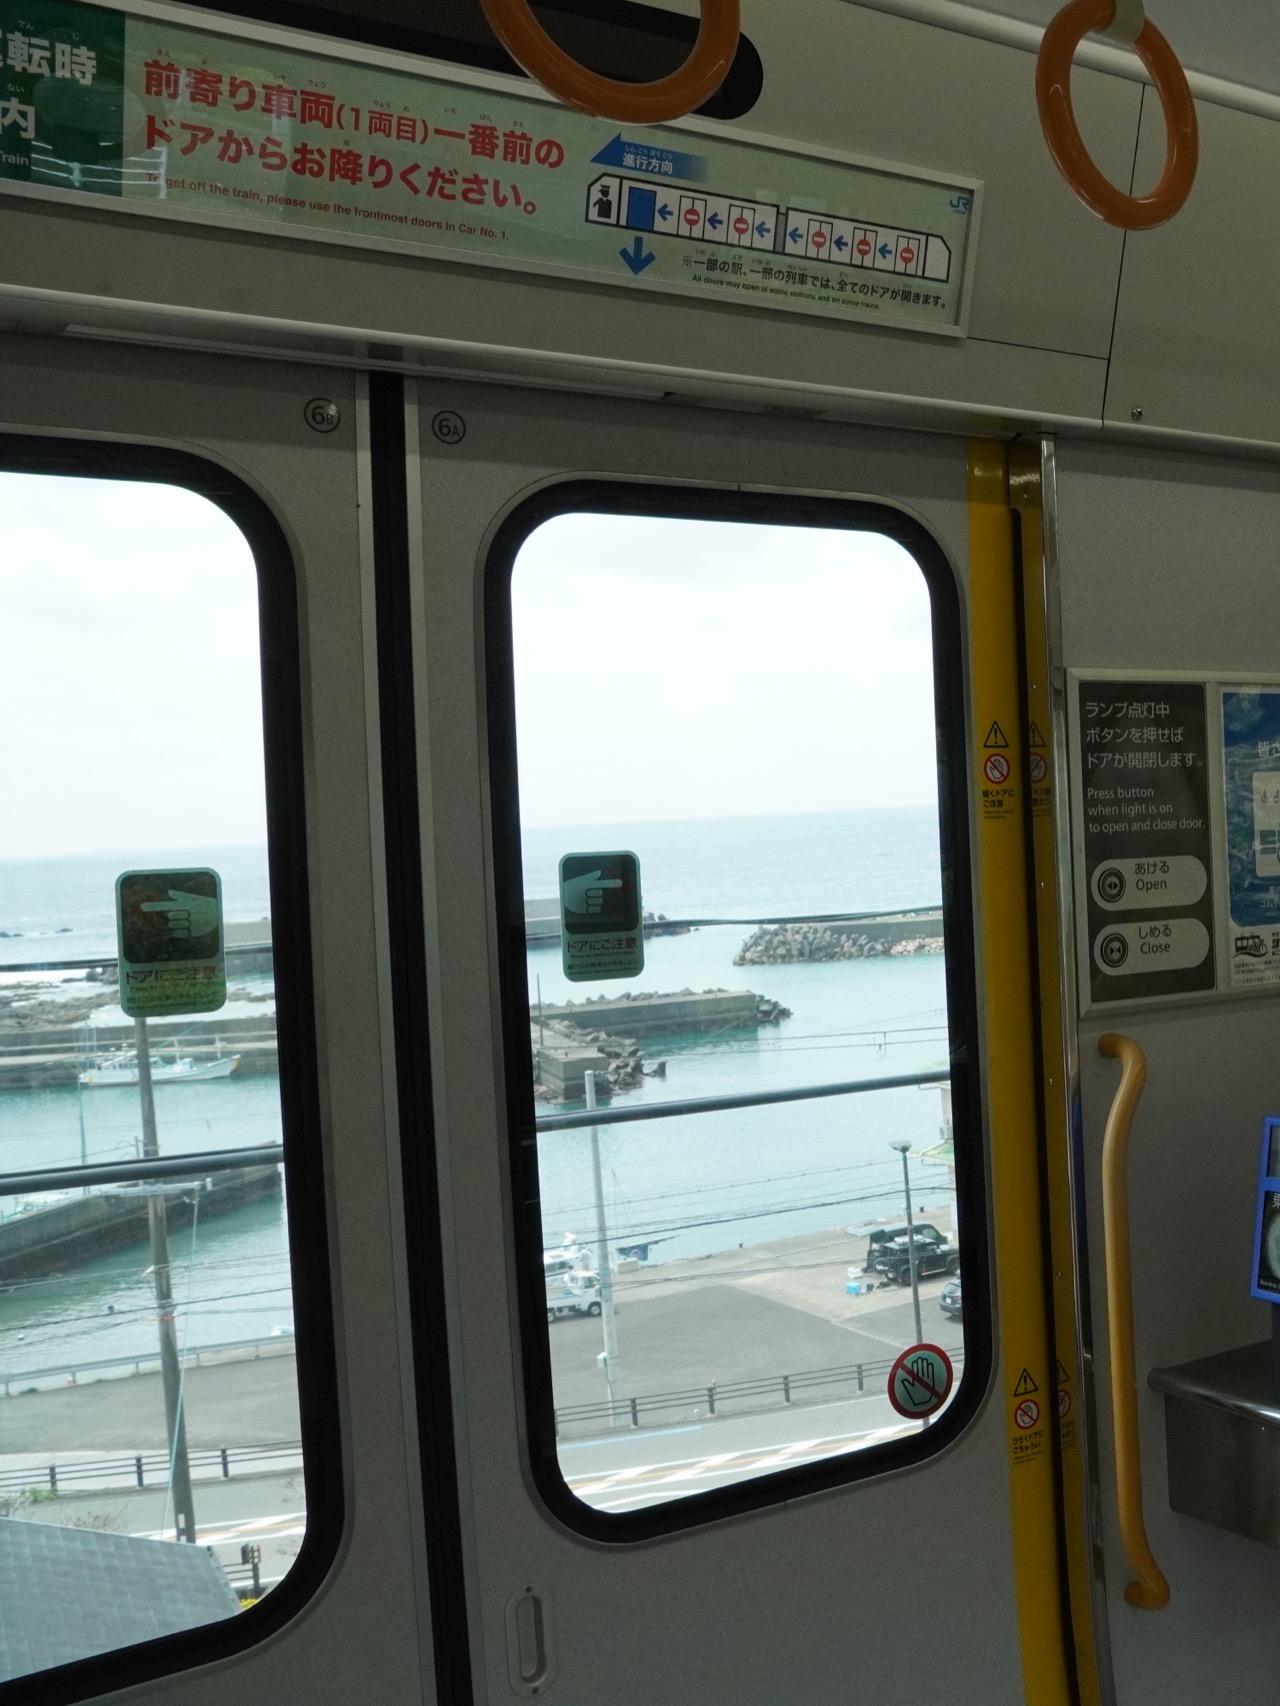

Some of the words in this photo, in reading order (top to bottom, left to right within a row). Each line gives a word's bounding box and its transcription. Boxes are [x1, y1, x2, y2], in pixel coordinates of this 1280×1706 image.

[0, 28, 97, 85] 転時
[143, 60, 565, 168] 前寄り車両(1両目)一番前の
[147, 115, 536, 214] ドアからお降りください。
[622, 152, 674, 174] 進行方向
[165, 177, 185, 190] get
[189, 180, 207, 191] off
[209, 183, 229, 196] the
[232, 187, 264, 203] train,
[266, 193, 306, 208] please
[309, 201, 330, 211] use
[333, 203, 351, 215] the
[354, 206, 408, 224] frontmost
[411, 216, 443, 230] doors
[445, 221, 455, 231] in
[458, 224, 477, 234] Car
[480, 226, 497, 239] No.
[950, 196, 970, 210] JR
[692, 274, 702, 283] All
[703, 276, 725, 286] doors
[725, 281, 741, 290] may
[742, 283, 760, 292] open
[769, 288, 789, 297] some
[817, 295, 831, 304] and
[841, 297, 860, 307] some
[438, 418, 460, 438] 6A
[1085, 701, 1170, 719] ランプ点灯中
[1086, 727, 1185, 743] ボタンを押せば
[1087, 751, 1203, 769] ドアが開閉します。
[1087, 787, 1115, 799] Press
[1117, 786, 1154, 798] button
[1087, 804, 1119, 816] when
[1121, 803, 1146, 817] light
[1149, 802, 1157, 813] is
[1159, 804, 1173, 813] on
[1089, 822, 1100, 833] to
[1102, 821, 1129, 835] open
[1131, 819, 1150, 831] and
[1152, 818, 1178, 830] close
[1179, 817, 1206, 829] door.
[1134, 861, 1170, 875] あける
[1136, 878, 1167, 893] Open
[1138, 924, 1172, 939] しめる
[567, 937, 638, 953] ドアにご注意
[1140, 942, 1171, 955] Close
[126, 965, 218, 984] ドアにご注意
